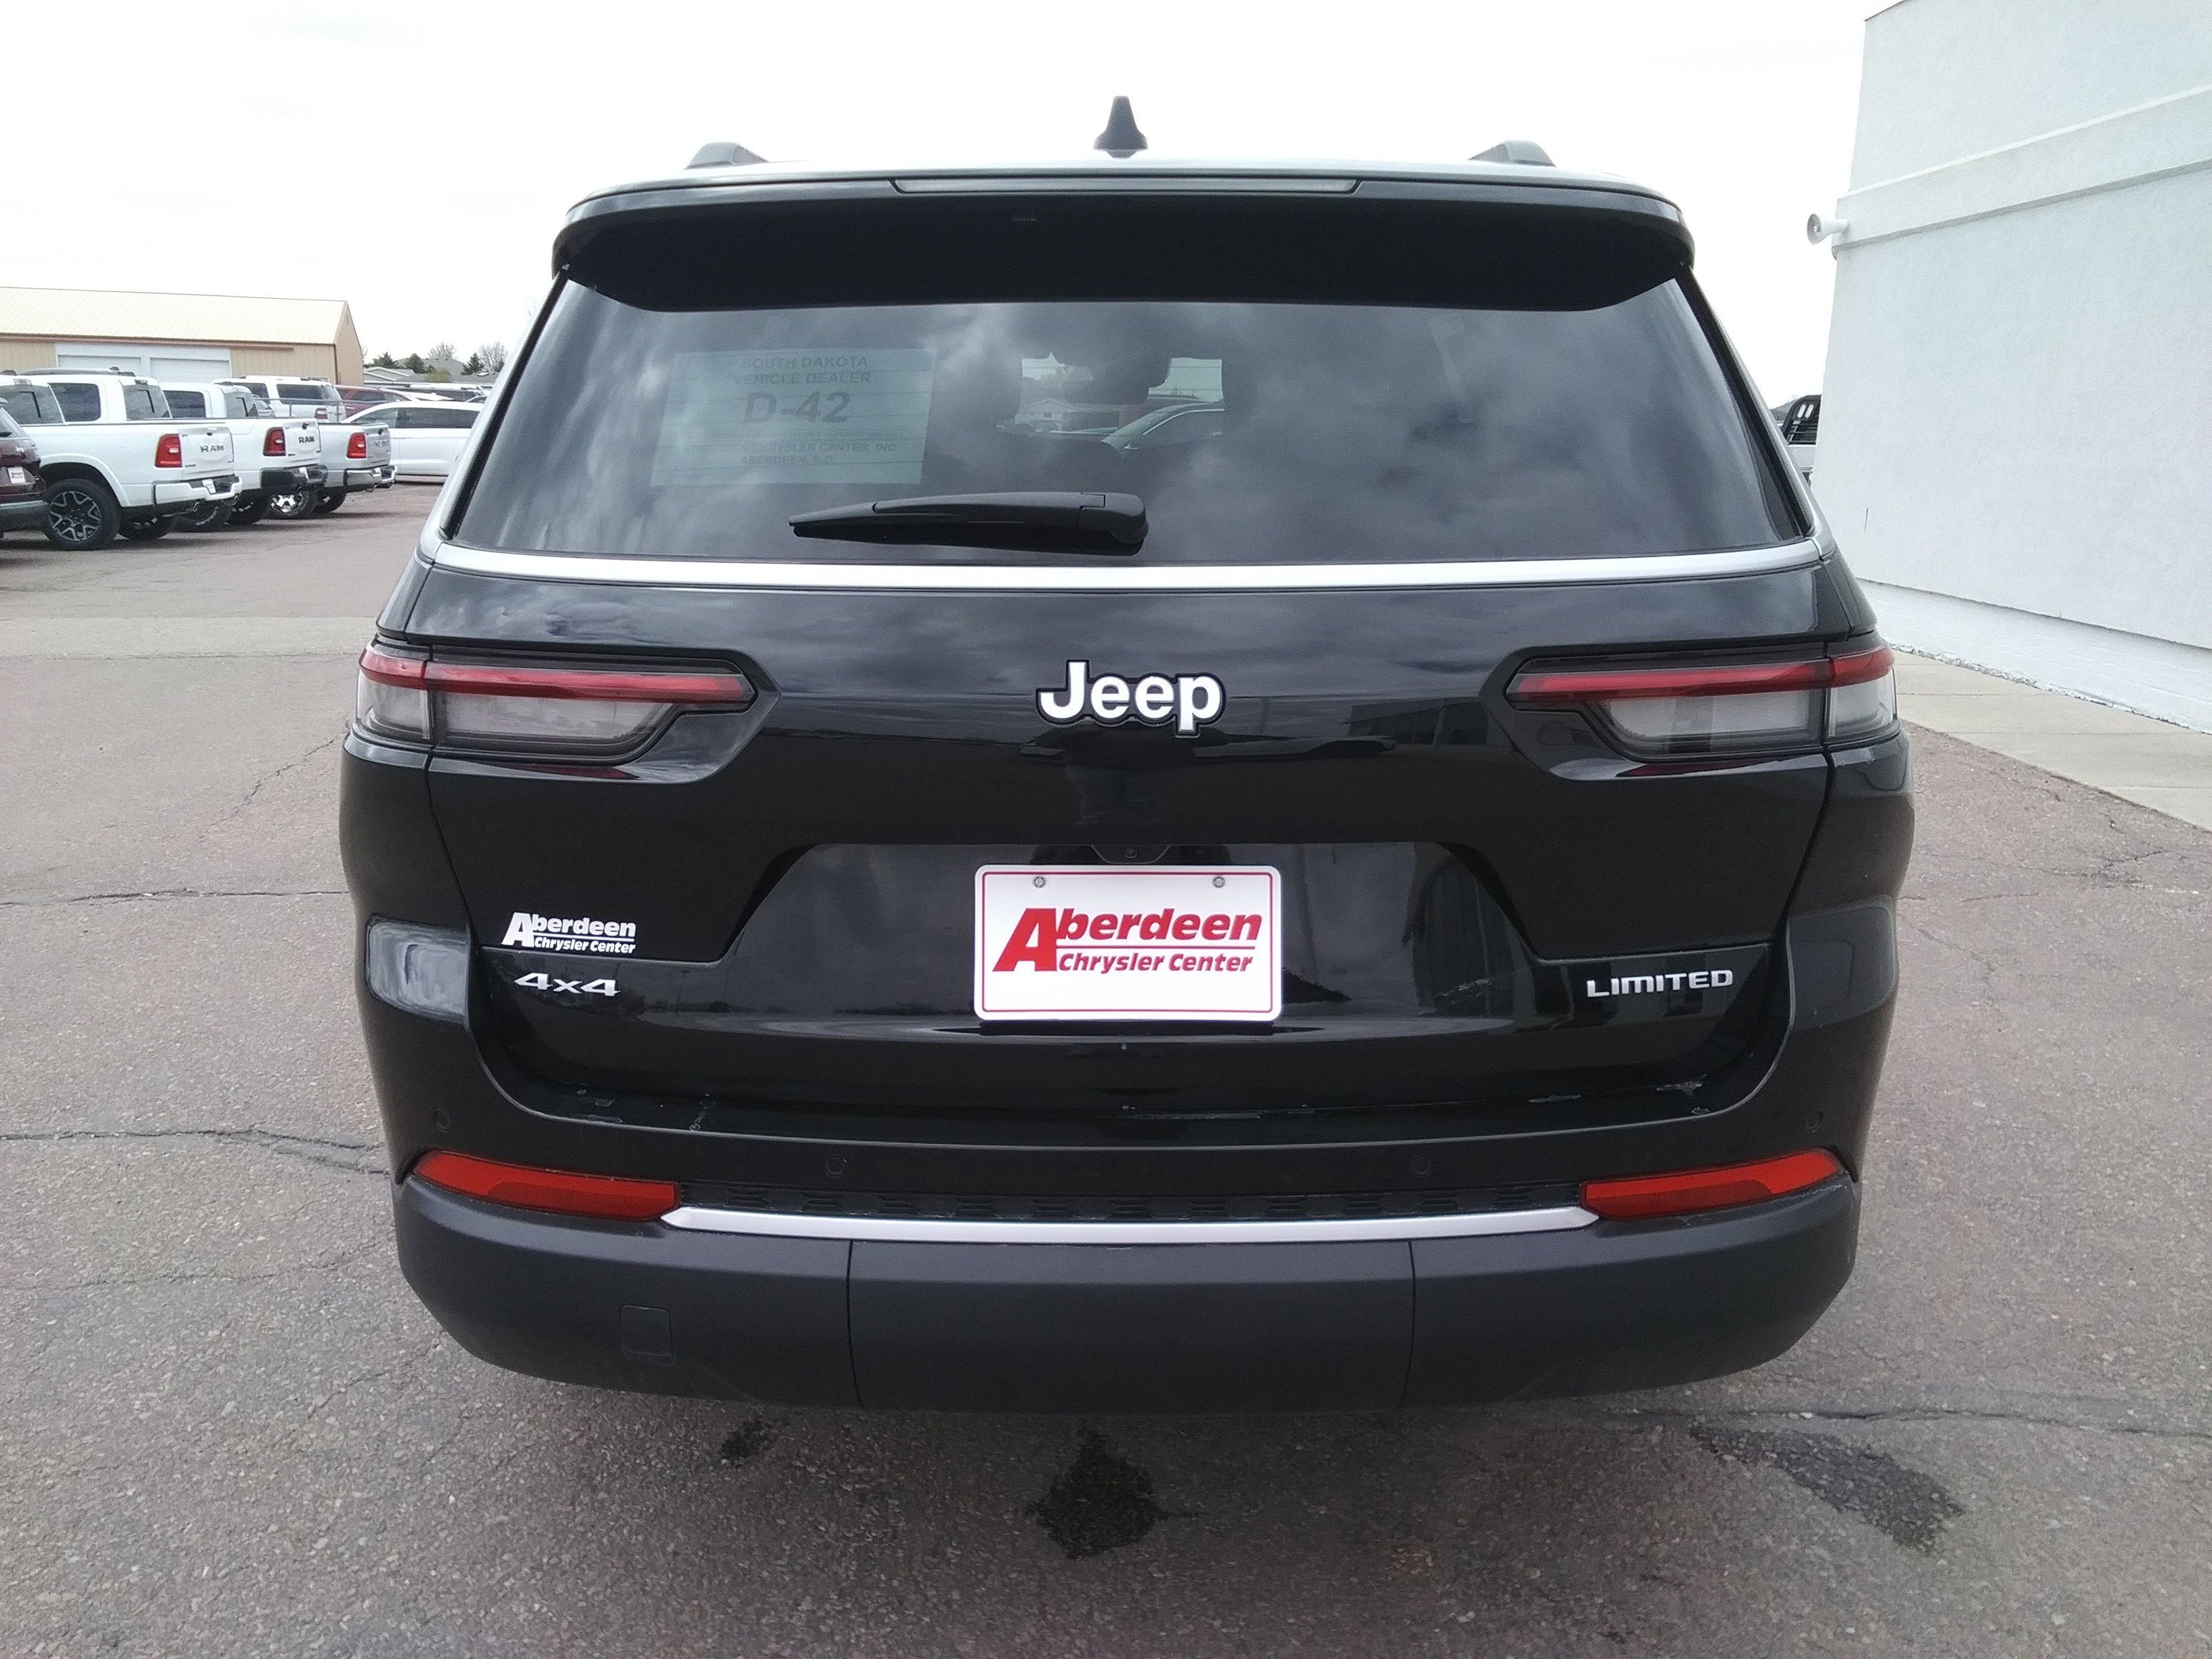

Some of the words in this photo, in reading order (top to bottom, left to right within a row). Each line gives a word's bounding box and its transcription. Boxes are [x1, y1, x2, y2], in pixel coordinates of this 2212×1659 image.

[742, 356, 796, 369] SOUTH
[801, 356, 868, 368] DAKOTA
[733, 372, 800, 385] VEHICLE
[805, 371, 871, 384] DEALER
[743, 391, 851, 424] D-42
[200, 445, 224, 453] RAM
[298, 436, 315, 444] RAM
[1037, 659, 1224, 734] Jeep
[501, 912, 637, 948] Aberdeen
[991, 907, 1263, 972] Aberdeen
[534, 936, 590, 951] Chrysler
[590, 940, 636, 954] Center
[1059, 952, 1164, 975] Chrysler
[1168, 952, 1254, 972] Center
[514, 972, 621, 997] 4x4
[1586, 969, 1734, 998] LIMITED
